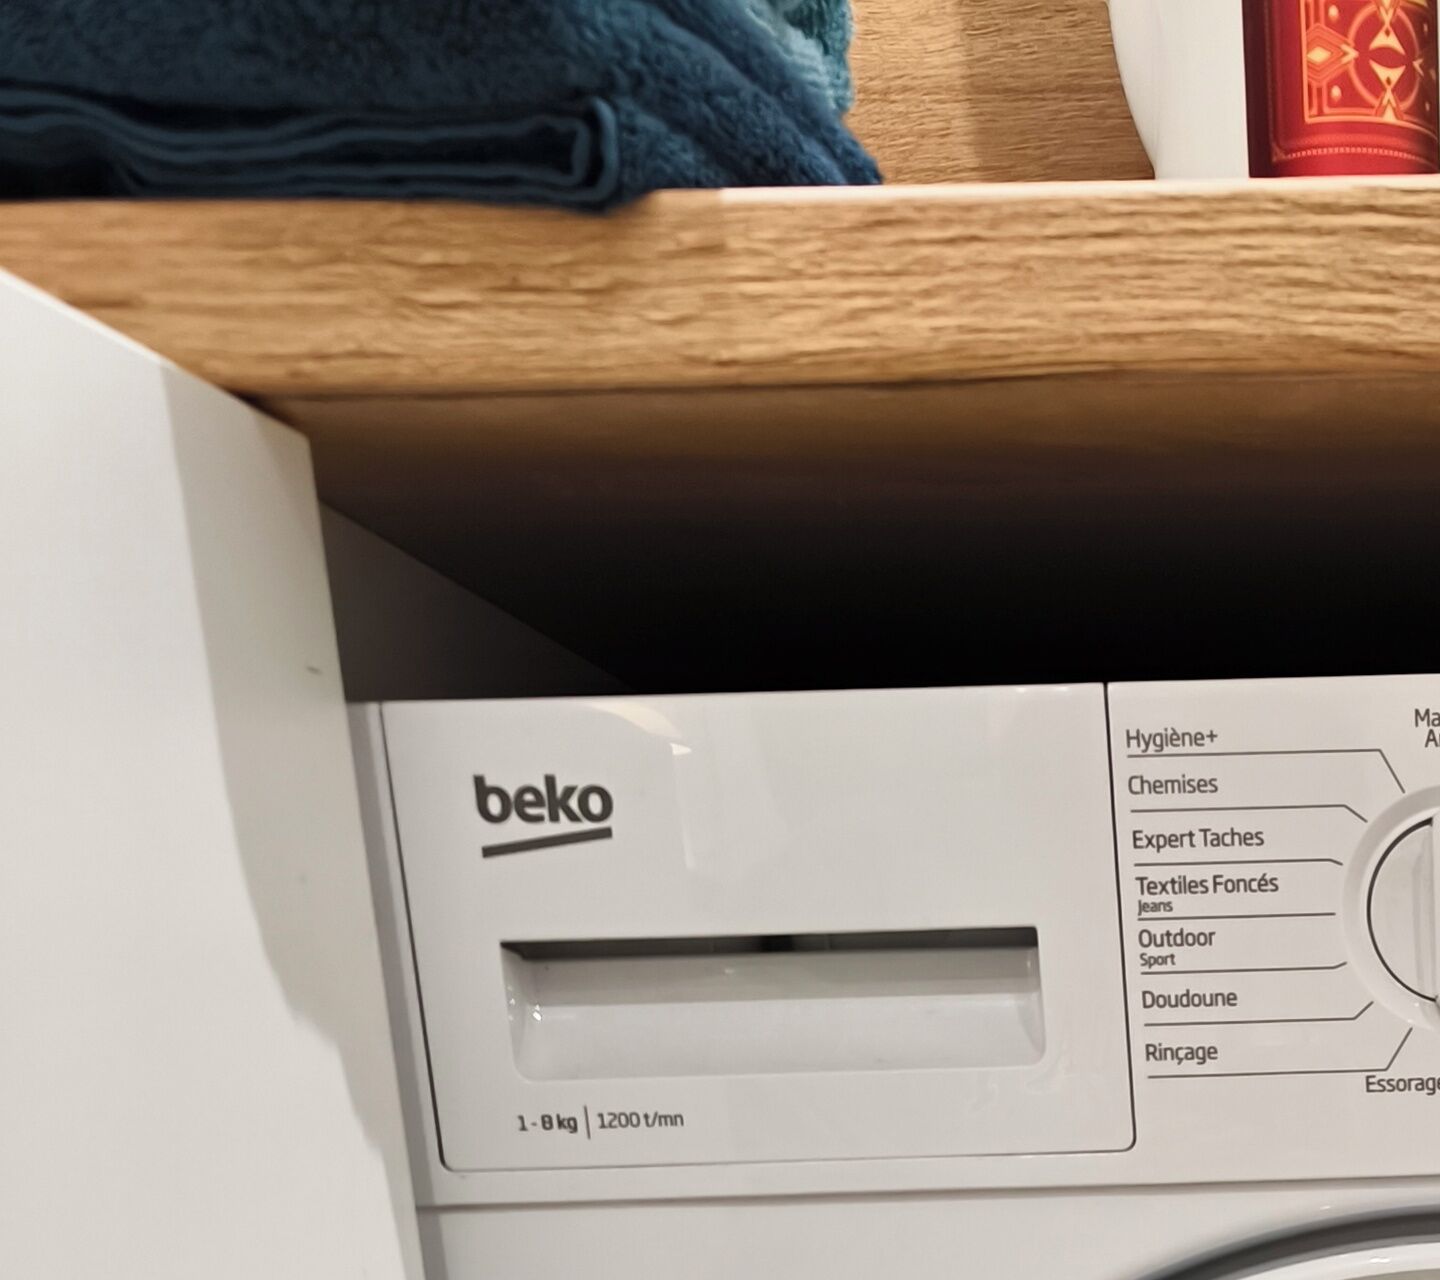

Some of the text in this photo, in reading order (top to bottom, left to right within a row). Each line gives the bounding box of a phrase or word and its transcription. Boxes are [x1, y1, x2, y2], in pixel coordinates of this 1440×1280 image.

[1126, 728, 1218, 752] Hygiène+
[1128, 774, 1218, 795] Chemises
[473, 774, 613, 824] beko
[1132, 828, 1264, 853] Expert Taches
[1136, 873, 1278, 895] Textiles Foncés
[1138, 900, 1173, 914] Jeans
[1139, 929, 1215, 948] Outdoor
[1140, 953, 1175, 968] Sport
[1141, 989, 1238, 1008] Doudoune
[1145, 1043, 1218, 1064] Rinçage
[557, 1113, 578, 1134] kg
[597, 1110, 684, 1130] 1200 t/mn
